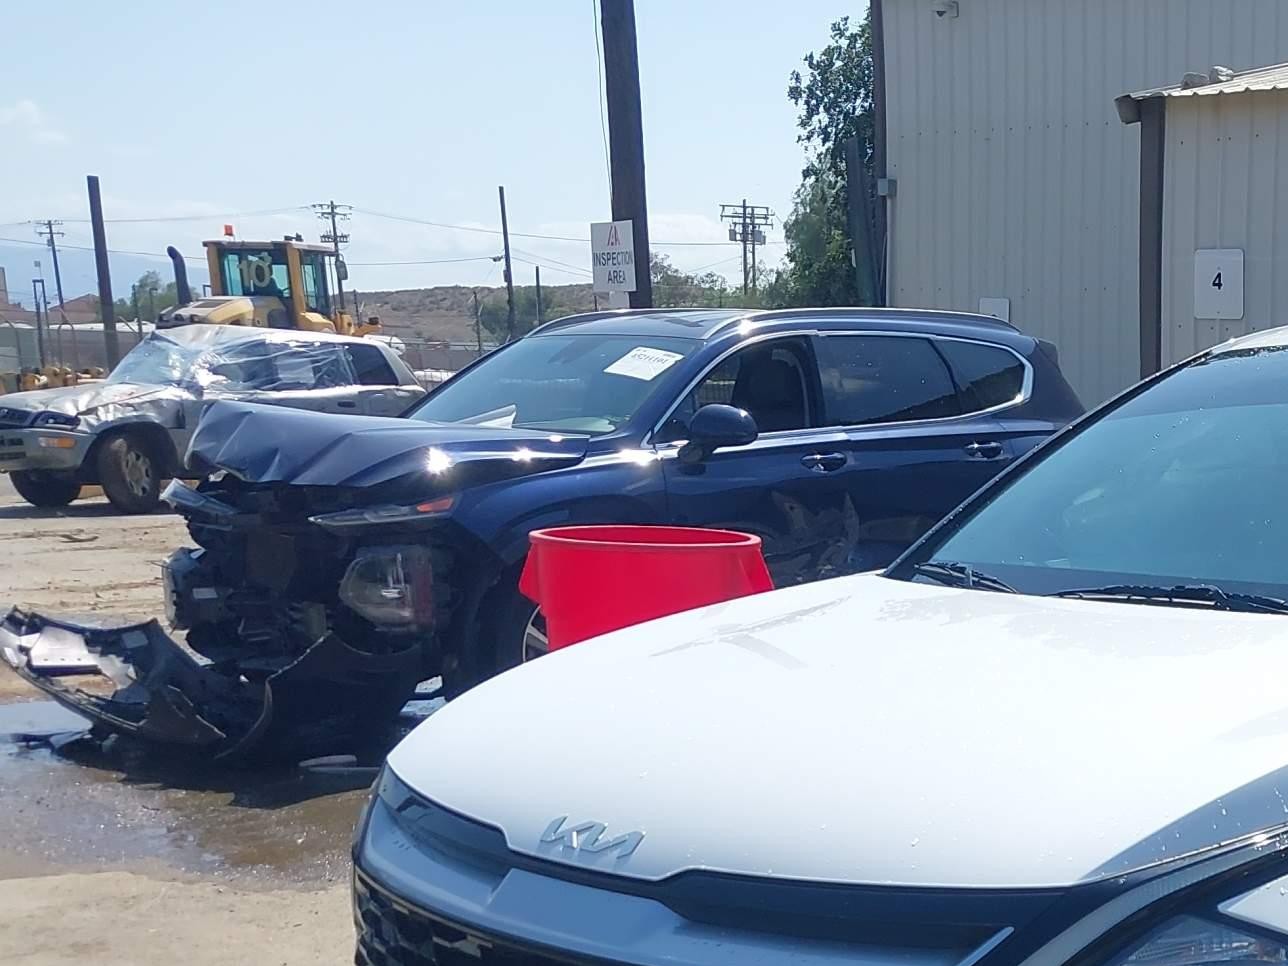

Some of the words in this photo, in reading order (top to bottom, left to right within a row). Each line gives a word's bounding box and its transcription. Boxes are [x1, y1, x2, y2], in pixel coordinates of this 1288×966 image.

[593, 250, 634, 267] INSPECTION
[608, 270, 626, 284] AREA
[1212, 271, 1223, 290] 4
